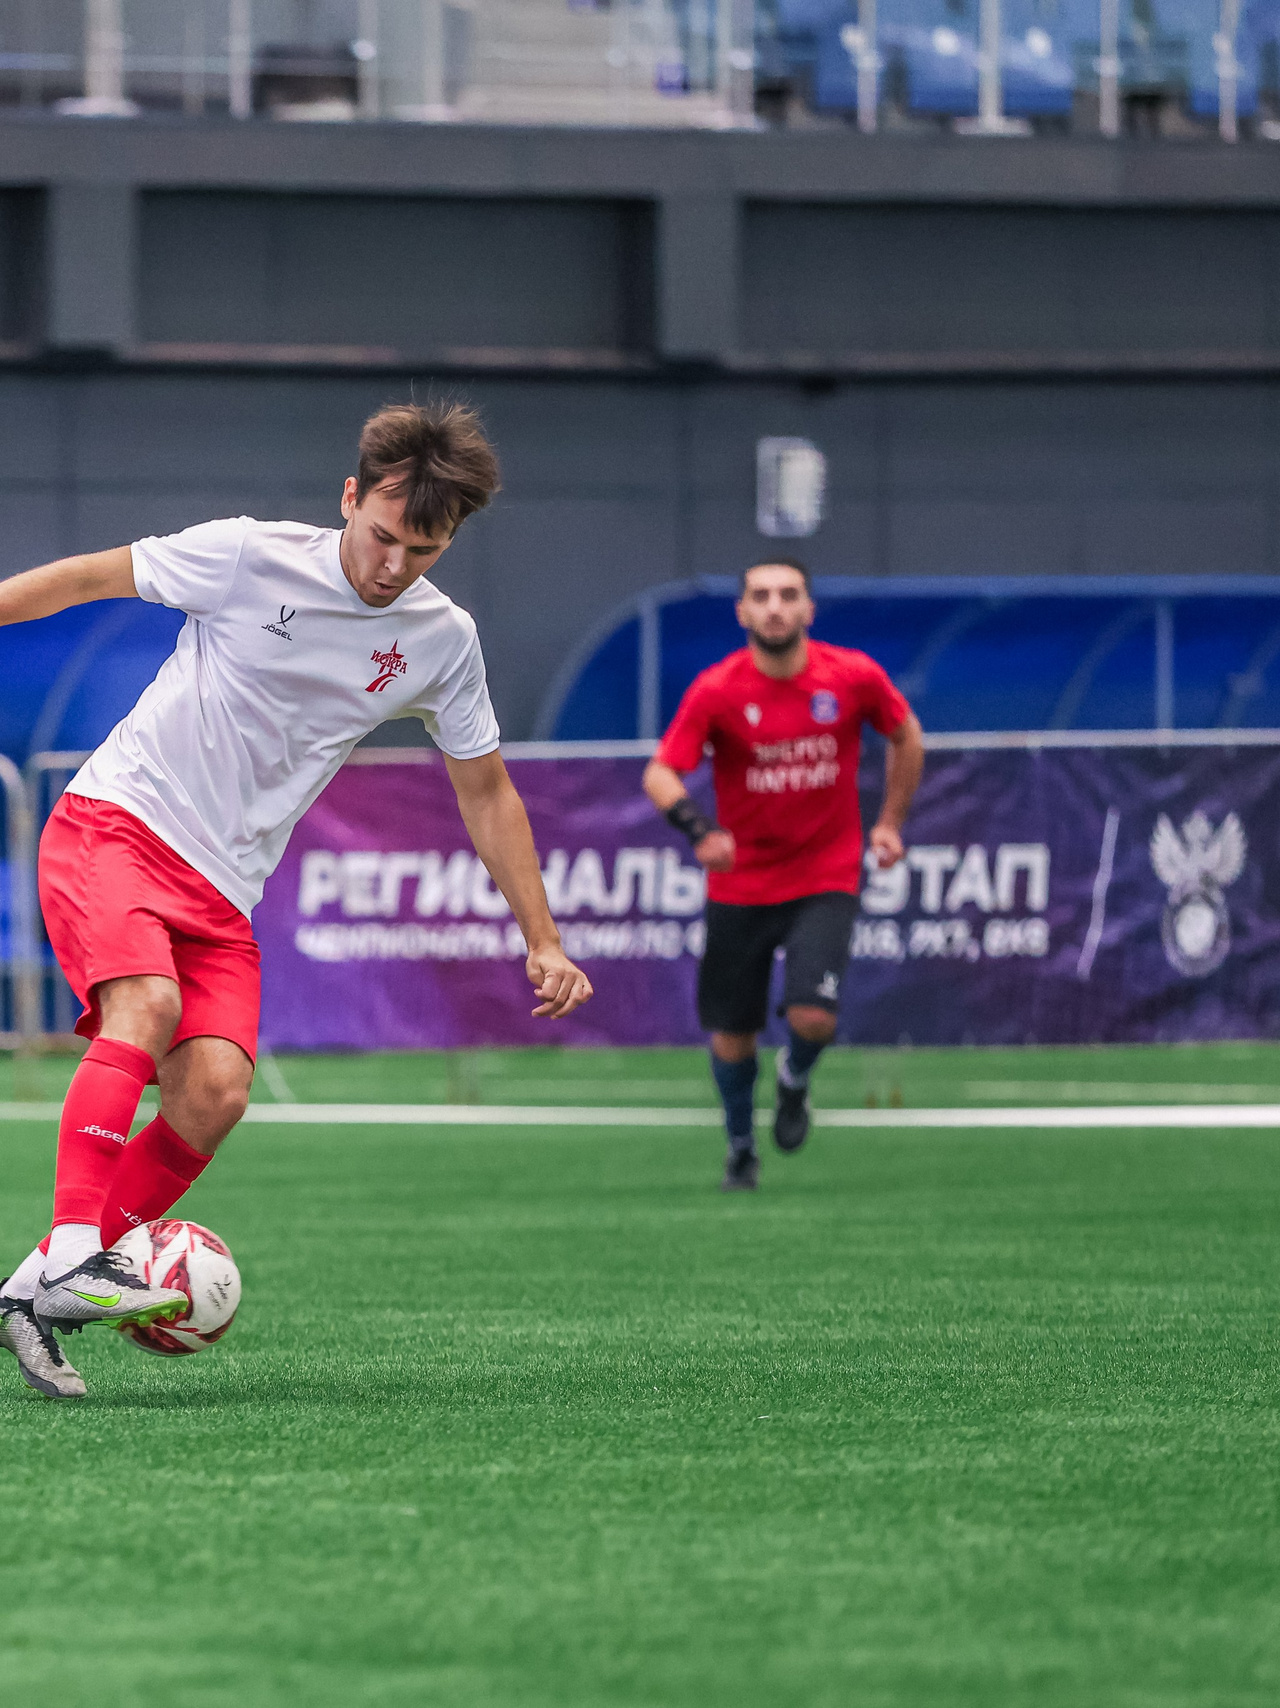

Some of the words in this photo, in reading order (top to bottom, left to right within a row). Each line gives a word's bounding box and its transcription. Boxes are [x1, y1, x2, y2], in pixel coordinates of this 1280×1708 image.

[261, 623, 293, 642] JÖGEL
[370, 649, 408, 675] ИСКРА
[297, 847, 706, 918] РЕГИОНАЛЬ
[860, 843, 1051, 915] ЭТАП
